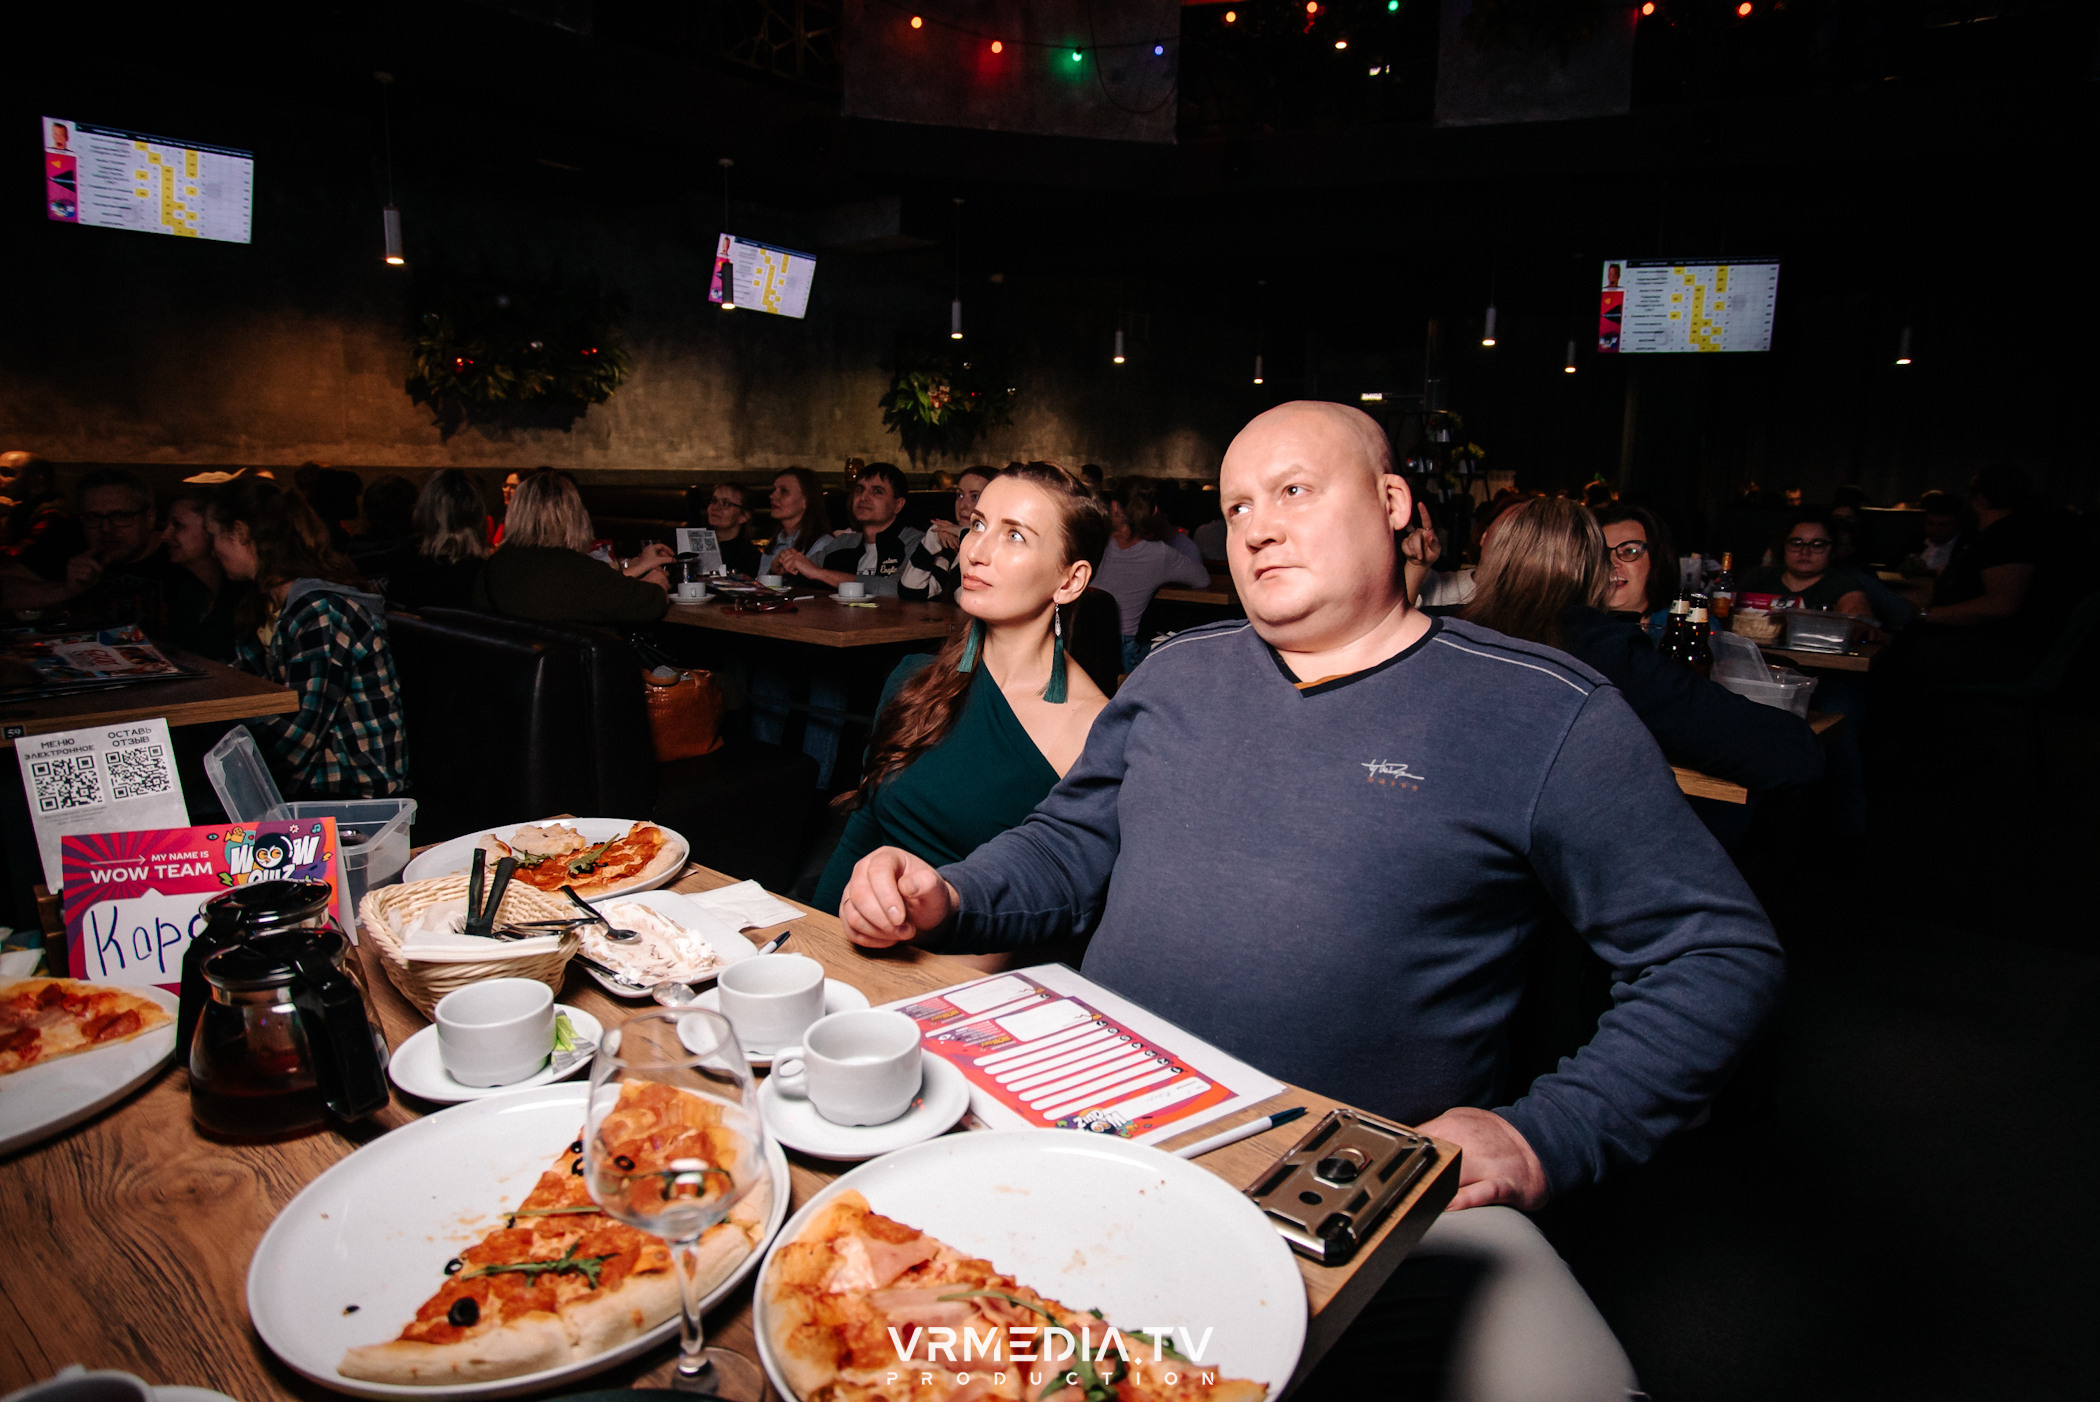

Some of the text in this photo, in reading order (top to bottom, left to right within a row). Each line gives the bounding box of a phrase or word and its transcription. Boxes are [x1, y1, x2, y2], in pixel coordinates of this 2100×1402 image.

[107, 727, 152, 739] ОСТАВЬ
[40, 738, 75, 749] МЕНЮ
[112, 736, 150, 747] ОТЗЫВ
[24, 744, 95, 761] ЭЛЕКТРОННОЕ
[151, 850, 210, 862] MY NAME IS
[90, 861, 213, 884] WOW TEAM
